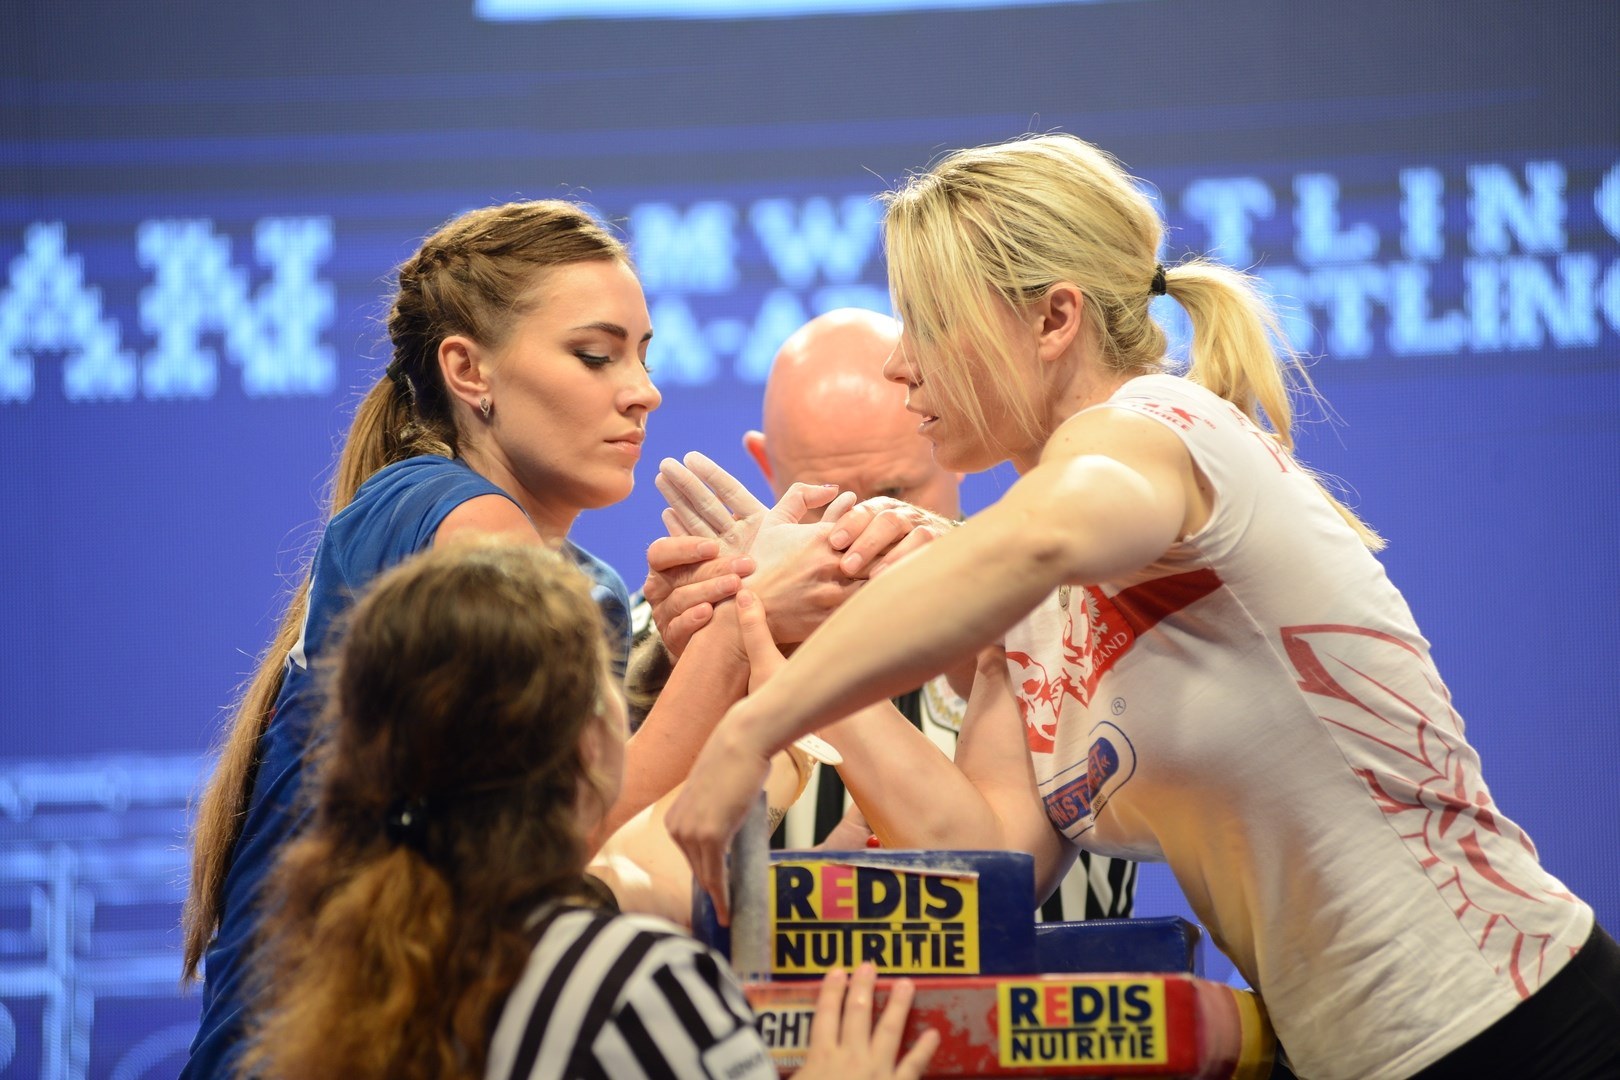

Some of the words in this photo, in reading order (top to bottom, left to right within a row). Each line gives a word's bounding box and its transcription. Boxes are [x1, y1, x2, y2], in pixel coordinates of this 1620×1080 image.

[776, 866, 964, 920] REDIS
[776, 923, 965, 968] NUTRITIE
[1010, 985, 1153, 1026] REDIS
[1011, 1028, 1155, 1061] NUTRITIE
